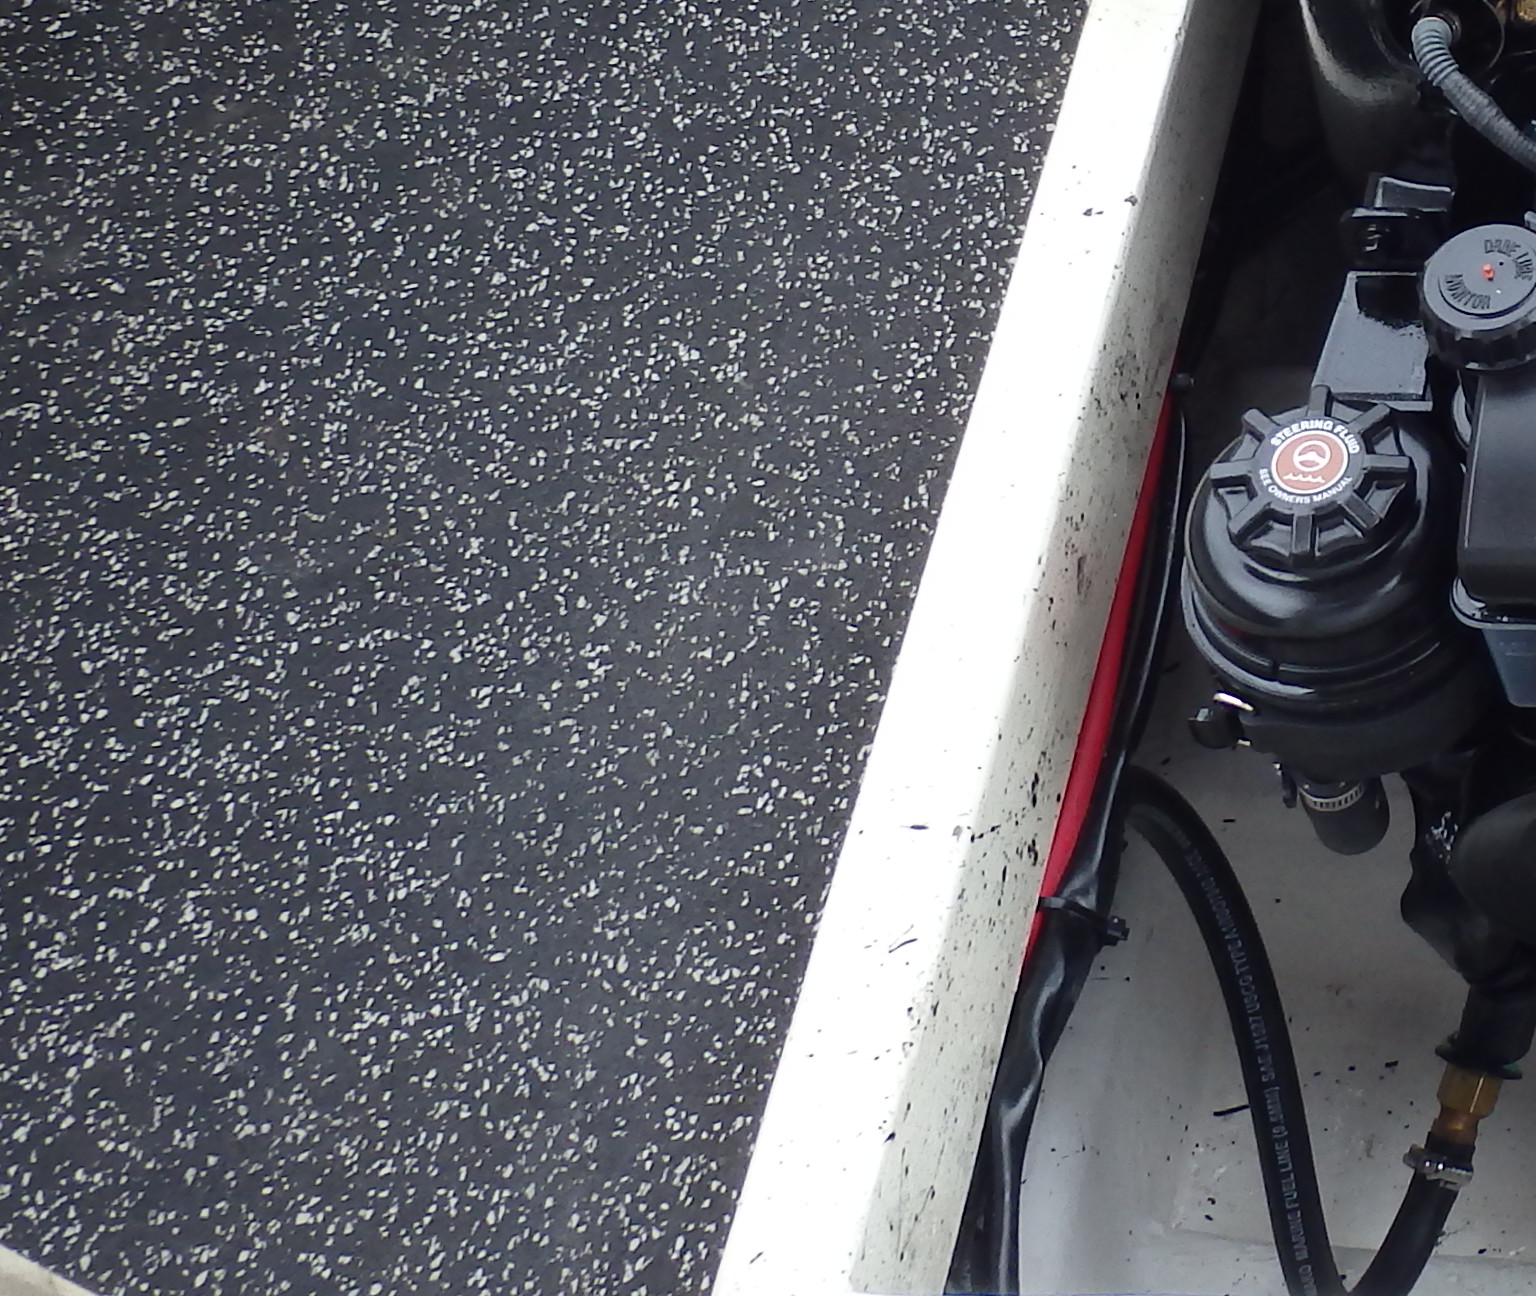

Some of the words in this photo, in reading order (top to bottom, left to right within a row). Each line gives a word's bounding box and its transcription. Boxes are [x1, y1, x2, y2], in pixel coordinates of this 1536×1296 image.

[1270, 419, 1333, 446] STEERING
[1333, 424, 1360, 455] FLUID
[1259, 467, 1270, 487] SEE
[1313, 475, 1353, 502] MANUAL
[1275, 1140, 1293, 1174] LINE
[1281, 1172, 1298, 1210] FUEL
